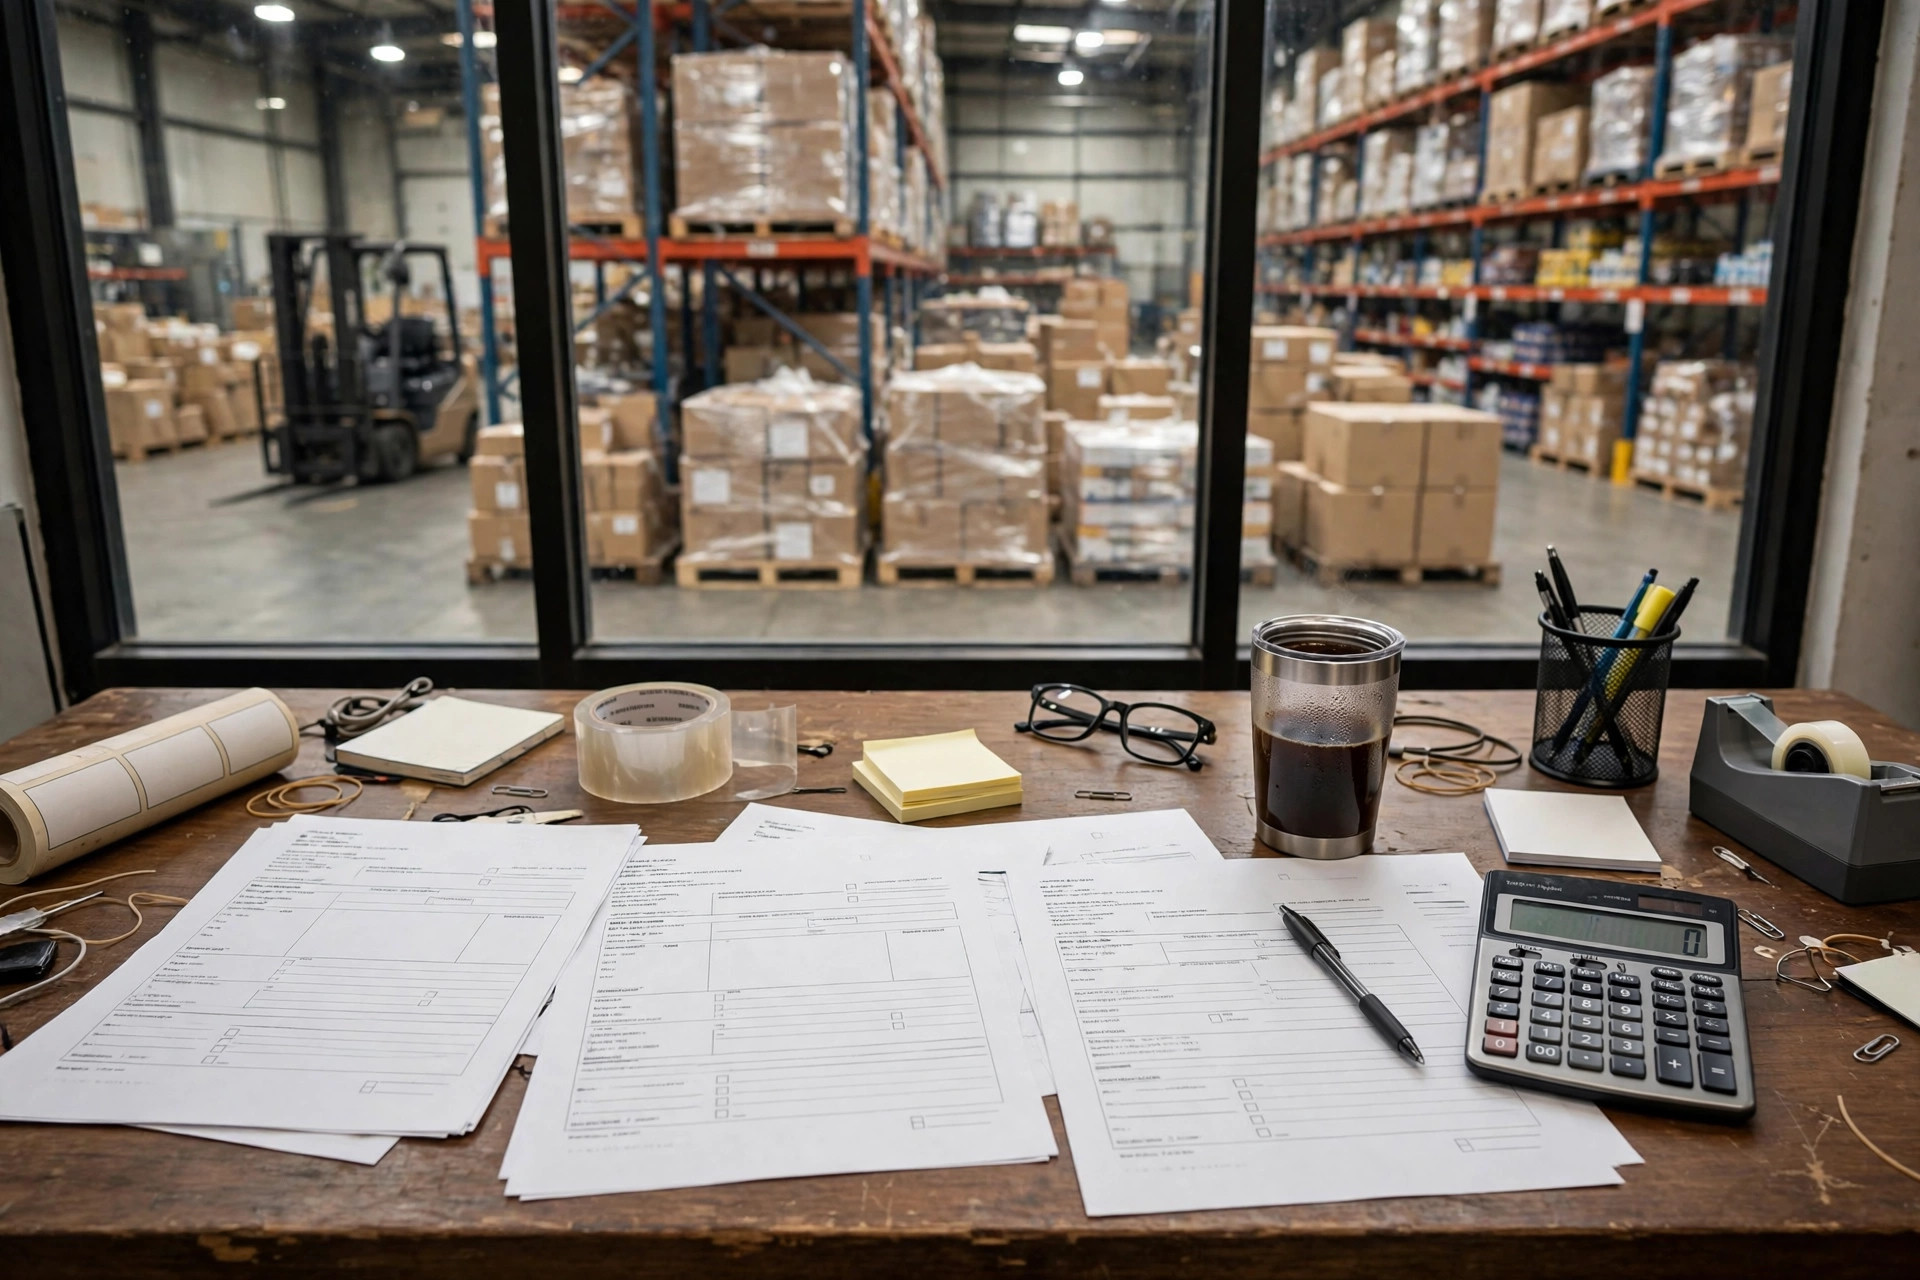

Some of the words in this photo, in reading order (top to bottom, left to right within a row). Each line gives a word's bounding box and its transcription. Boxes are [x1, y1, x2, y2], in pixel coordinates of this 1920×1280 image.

[1683, 929, 1701, 956] 0
[1545, 977, 1553, 985] 7
[1581, 983, 1592, 991] 8
[1620, 989, 1631, 997] 9
[1544, 994, 1553, 1002] 7
[1581, 999, 1592, 1008] 8
[1541, 1011, 1551, 1019] 4
[1620, 1006, 1631, 1015] 9
[1582, 1016, 1591, 1025] 5
[1621, 1023, 1632, 1032] 6
[1581, 1034, 1591, 1044] 2
[1622, 1040, 1632, 1050] 3
[1534, 1045, 1556, 1057] 00
